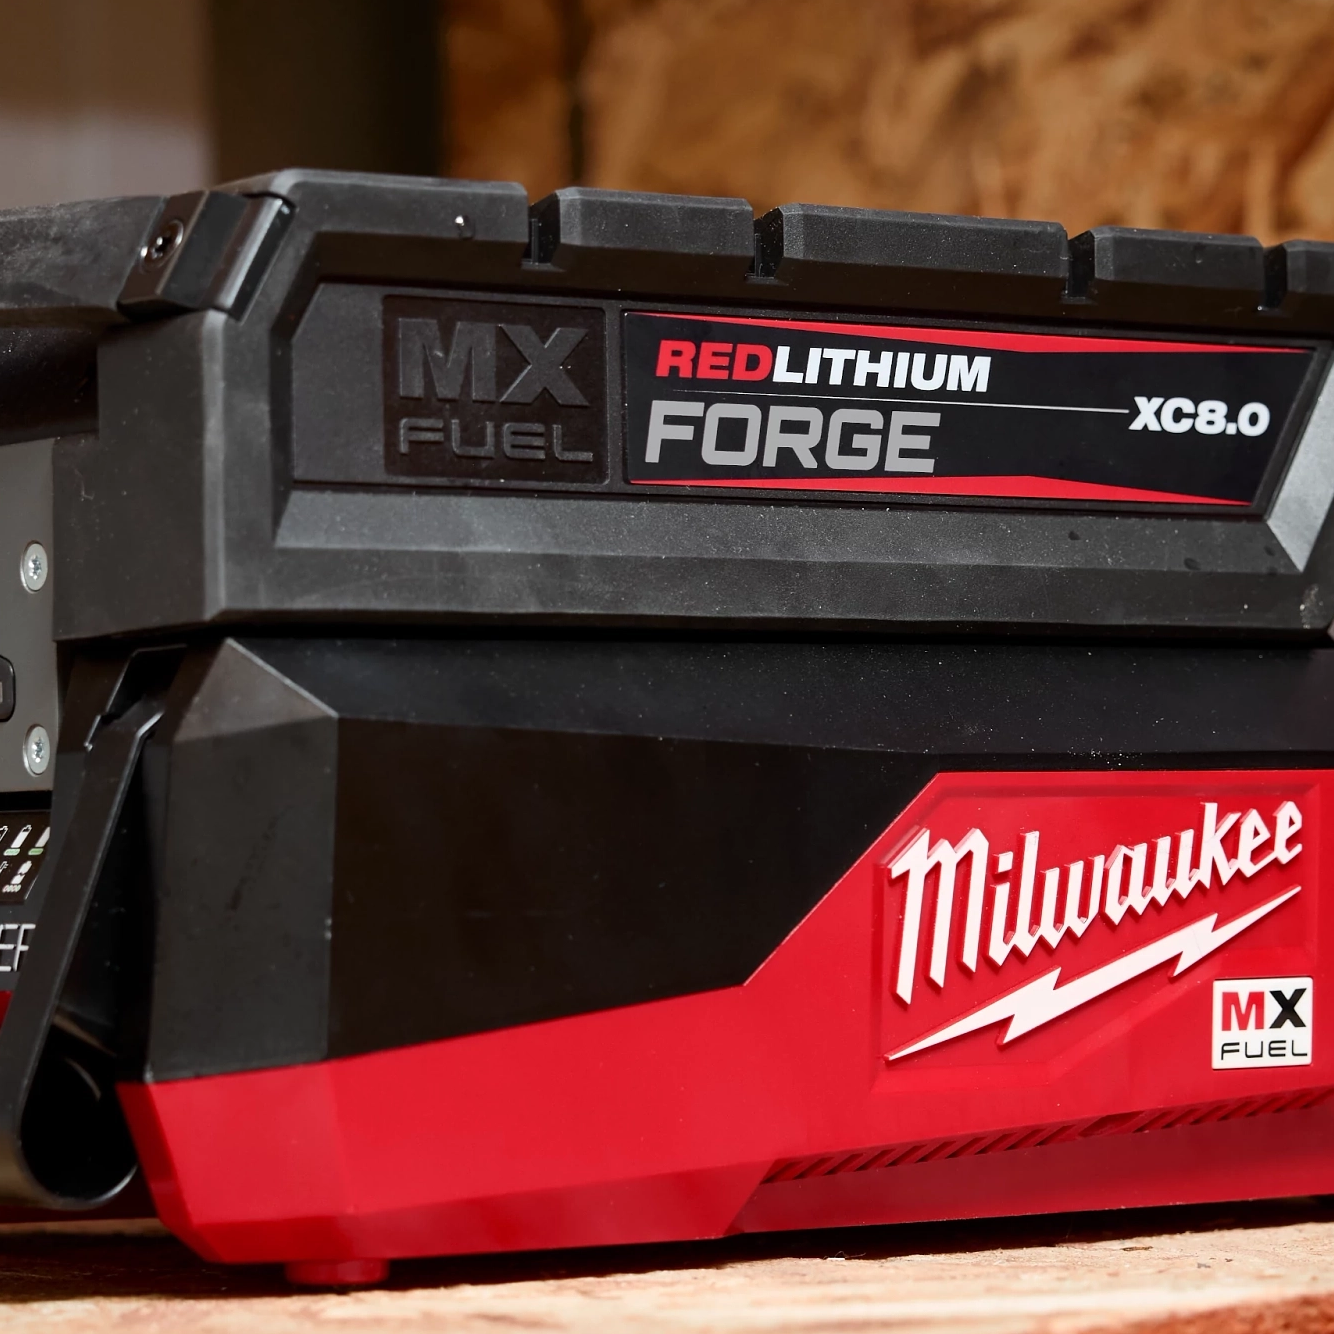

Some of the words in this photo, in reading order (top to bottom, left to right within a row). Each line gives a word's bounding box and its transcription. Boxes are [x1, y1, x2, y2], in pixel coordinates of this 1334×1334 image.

[399, 318, 590, 407] MX
[655, 340, 992, 392] REDLITHIUM
[645, 400, 941, 473] FORGE
[1128, 396, 1270, 436] XC8.0
[399, 418, 593, 463] FUEL
[889, 801, 1302, 1005] Milwaukee
[1222, 988, 1307, 1031] MX
[1221, 1039, 1308, 1060] FUEL
